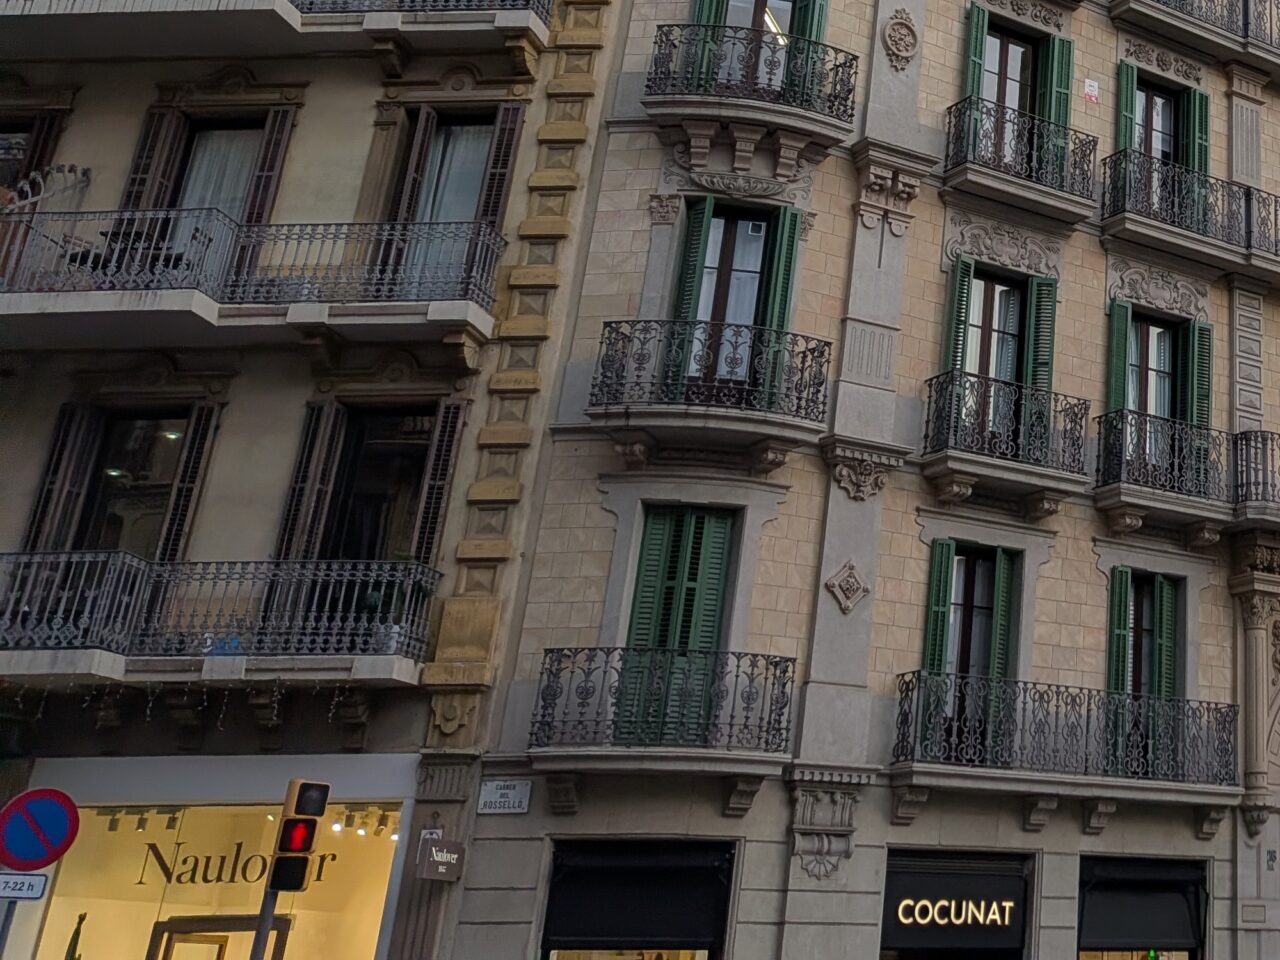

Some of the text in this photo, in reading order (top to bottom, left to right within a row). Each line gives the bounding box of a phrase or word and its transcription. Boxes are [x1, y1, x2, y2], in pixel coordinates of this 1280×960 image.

[135, 841, 337, 886] Naulor
[3, 881, 34, 891] 7-22 h
[898, 899, 1014, 925] COCUNAT
